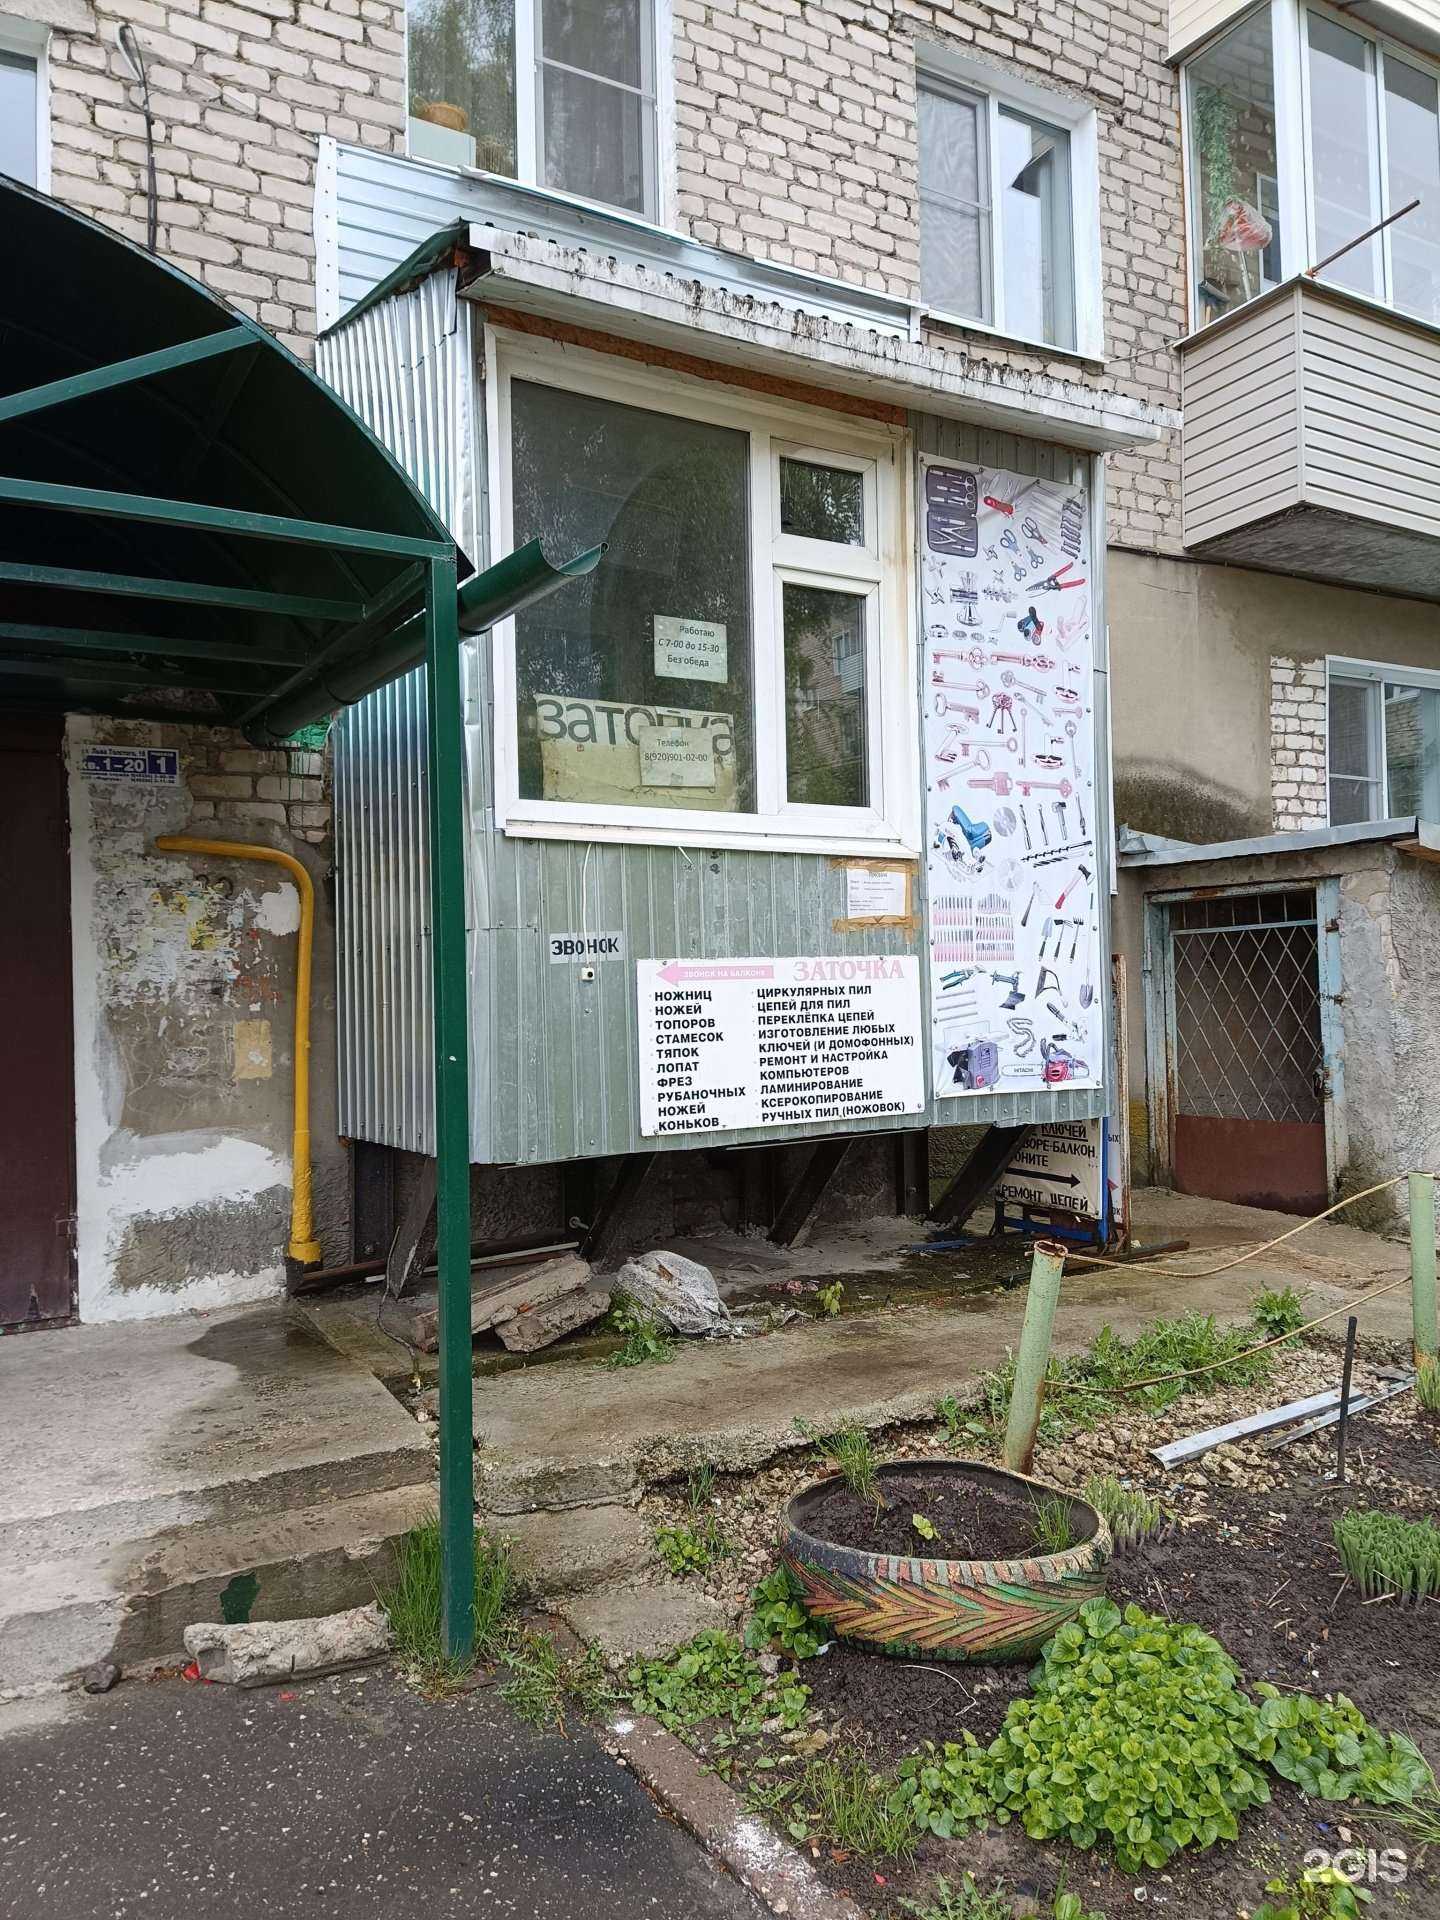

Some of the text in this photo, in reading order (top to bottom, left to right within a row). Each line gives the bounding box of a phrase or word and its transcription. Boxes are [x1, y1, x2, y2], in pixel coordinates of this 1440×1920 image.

[679, 625, 715, 638] Работаю
[665, 639, 684, 649] 7-00
[685, 640, 696, 651] до
[697, 642, 720, 653] 15-30
[667, 654, 710, 668] Без обеда
[104, 758, 144, 772] 1-20
[157, 757, 166, 772] 1
[551, 937, 619, 955] ЗВОНОК
[793, 959, 905, 982] ЗАТОЧКА
[655, 990, 712, 1002] НОЖНИЦ
[757, 985, 872, 999] ЦИРКУЛЯРНЫХ ПИЛ
[655, 1002, 702, 1016] НОЖЕЙ
[757, 998, 851, 1013] ЦЕПЕЙ ДЛЯ ПИЛ
[655, 1018, 716, 1030] ТОПОРОВ
[758, 1010, 875, 1026] ПЕРЕКЛЁПКА ЦЕПЕЙ
[656, 1031, 724, 1045] СТАМЕСОК
[758, 1023, 896, 1039] ИЗГОТОВЛЕНИЕ ЛЮБЫХ
[759, 1035, 914, 1053] КЛЮЧЕЙ (И ДОМОФОННЫХ)
[656, 1047, 699, 1059] ТЯПОК
[759, 1049, 889, 1067] РЕМОНТ И НАСТРОЙКА
[656, 1061, 700, 1074] ЛОПАТ
[760, 1066, 850, 1081] КОМПЬЮТЕРОВ
[657, 1075, 693, 1088] ФРЕЗ
[760, 1078, 863, 1095] ЛАМИНИРОВАНИЕ
[657, 1086, 746, 1103] РУБАНОЧНЫХ
[761, 1090, 883, 1109] КСЕРОКОПИРОВАНИЕ
[658, 1101, 706, 1117] НОЖЕЙ
[761, 1101, 906, 1123] РУЧНЫХ ПИЛ (НОЖОВОК)
[658, 1117, 719, 1132] КОНЬКОВ
[1001, 1184, 1044, 1203] РЕМОНТ
[1050, 1193, 1089, 1212] ЦЕПЕЙ
